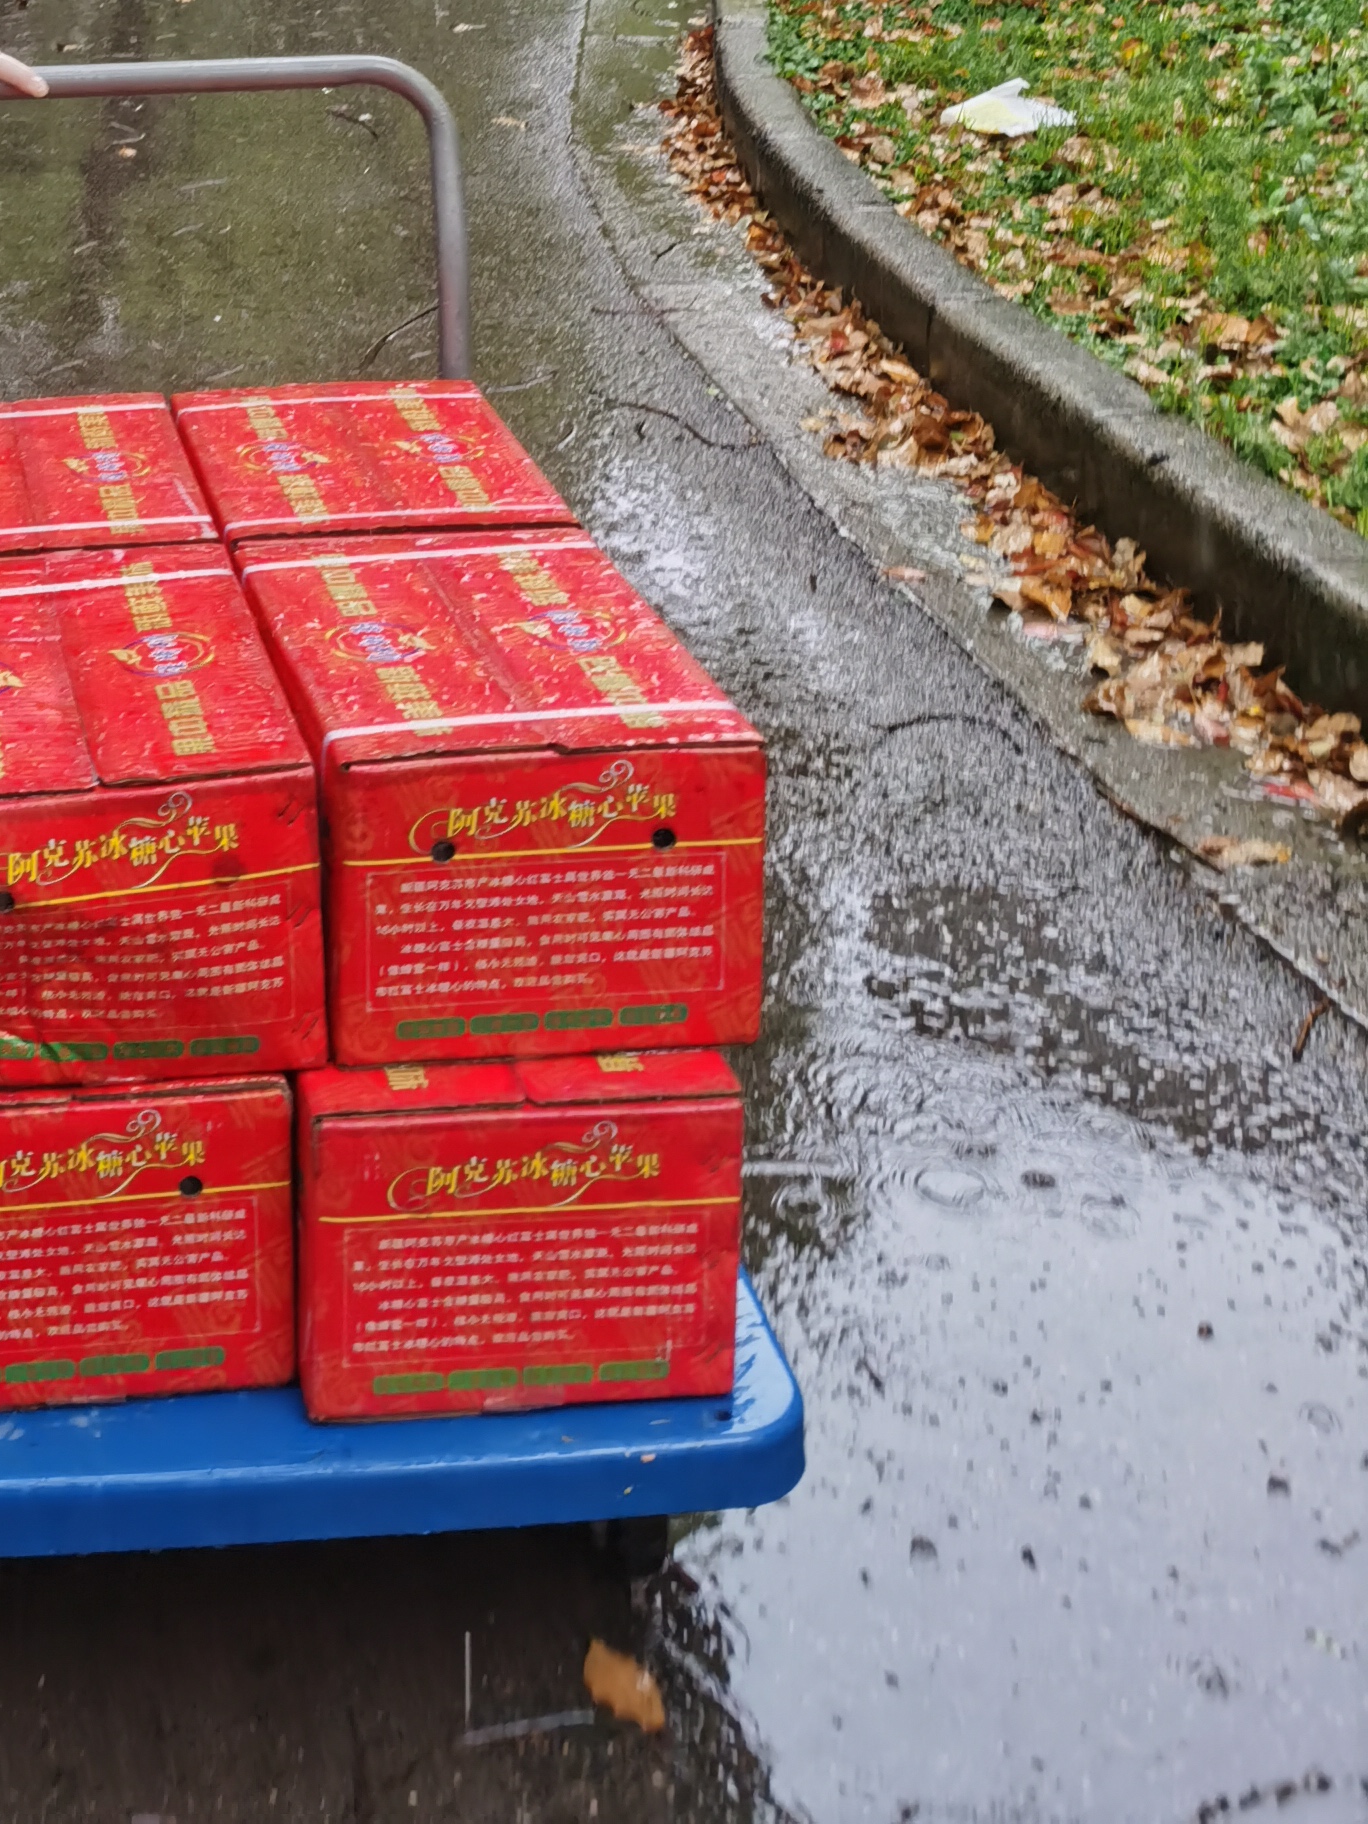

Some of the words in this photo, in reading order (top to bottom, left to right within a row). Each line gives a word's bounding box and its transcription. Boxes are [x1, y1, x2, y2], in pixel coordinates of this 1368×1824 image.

[447, 784, 677, 838] 阿克苏冰糖心苹果
[7, 816, 239, 885] 阿克苏冰糖心苹果
[427, 1144, 660, 1196] 阿克苏冰糖心苹果
